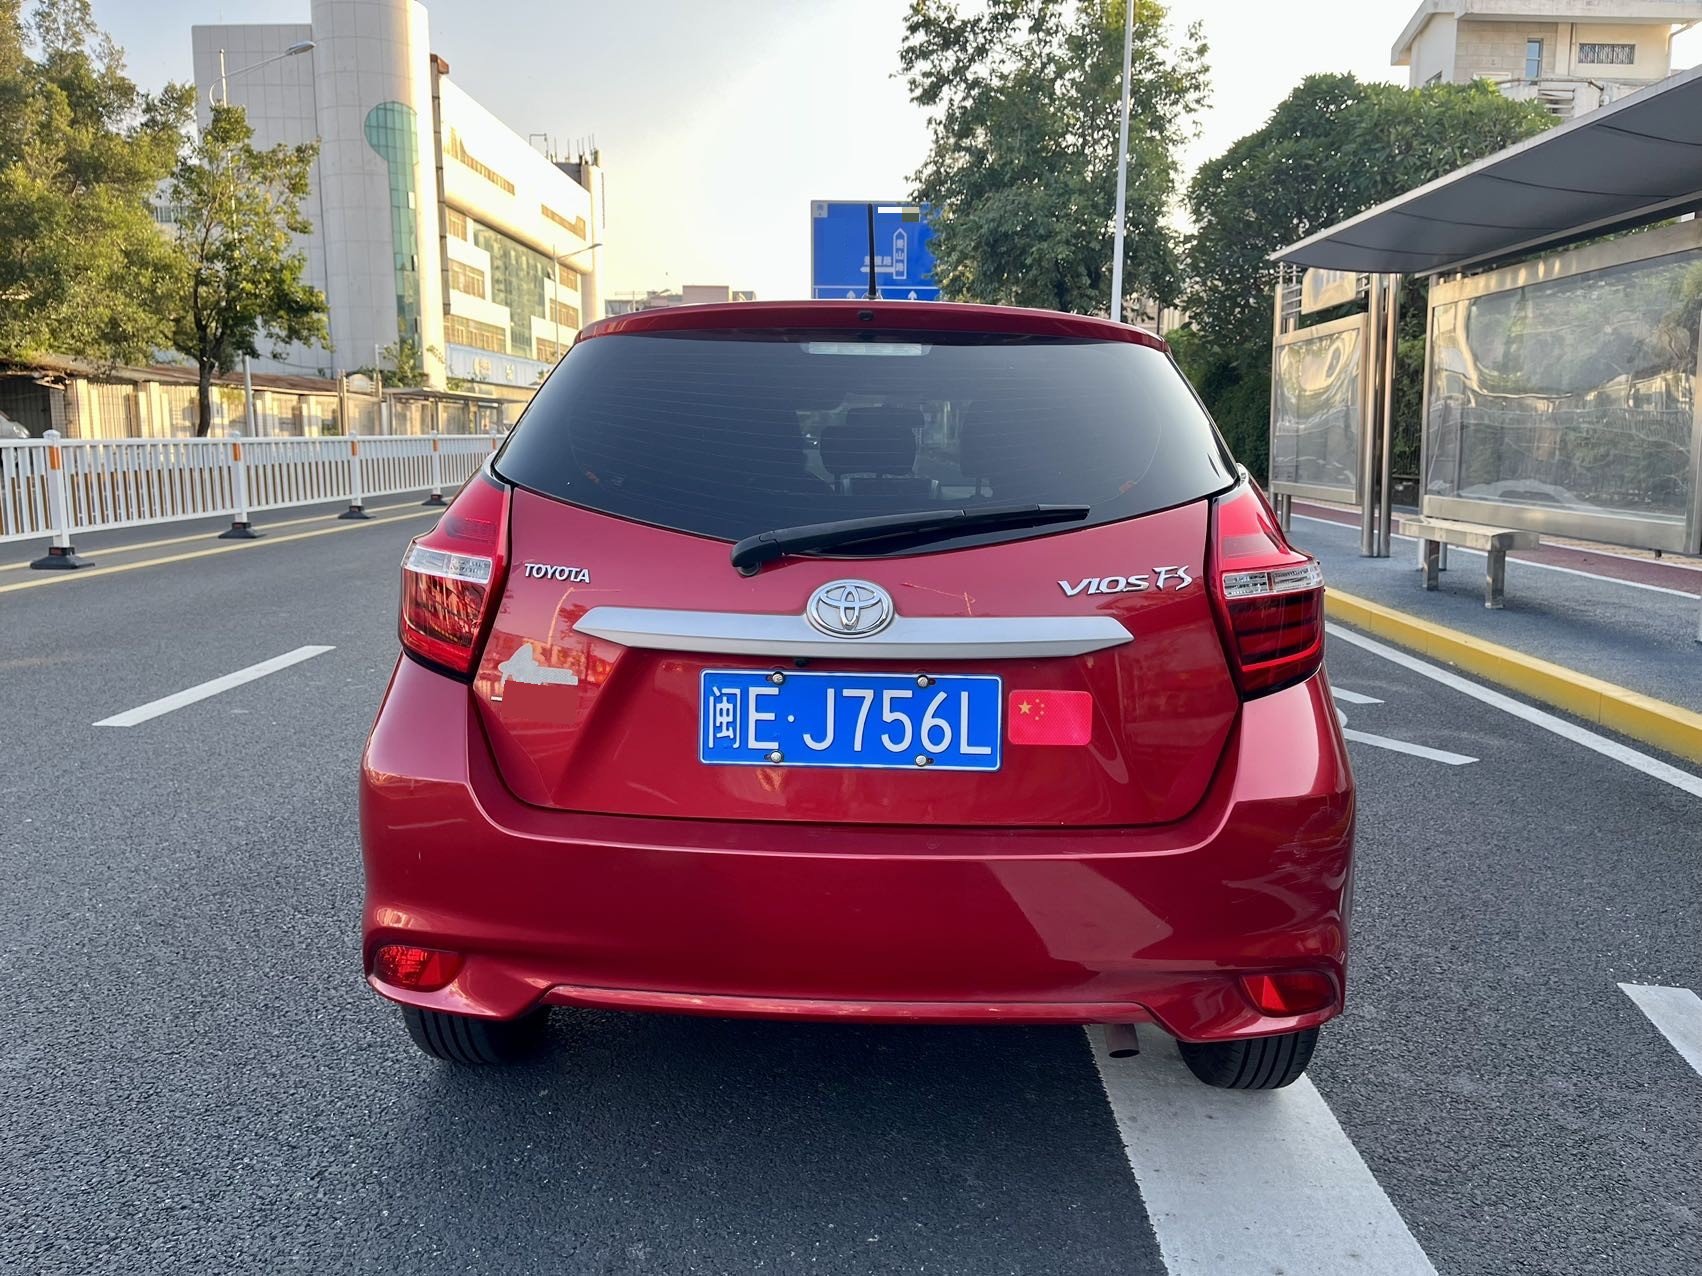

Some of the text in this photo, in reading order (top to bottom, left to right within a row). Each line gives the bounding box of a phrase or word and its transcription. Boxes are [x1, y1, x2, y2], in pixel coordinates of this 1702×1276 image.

[524, 563, 591, 584] TOYOTA
[1057, 565, 1193, 597] VIOS FS
